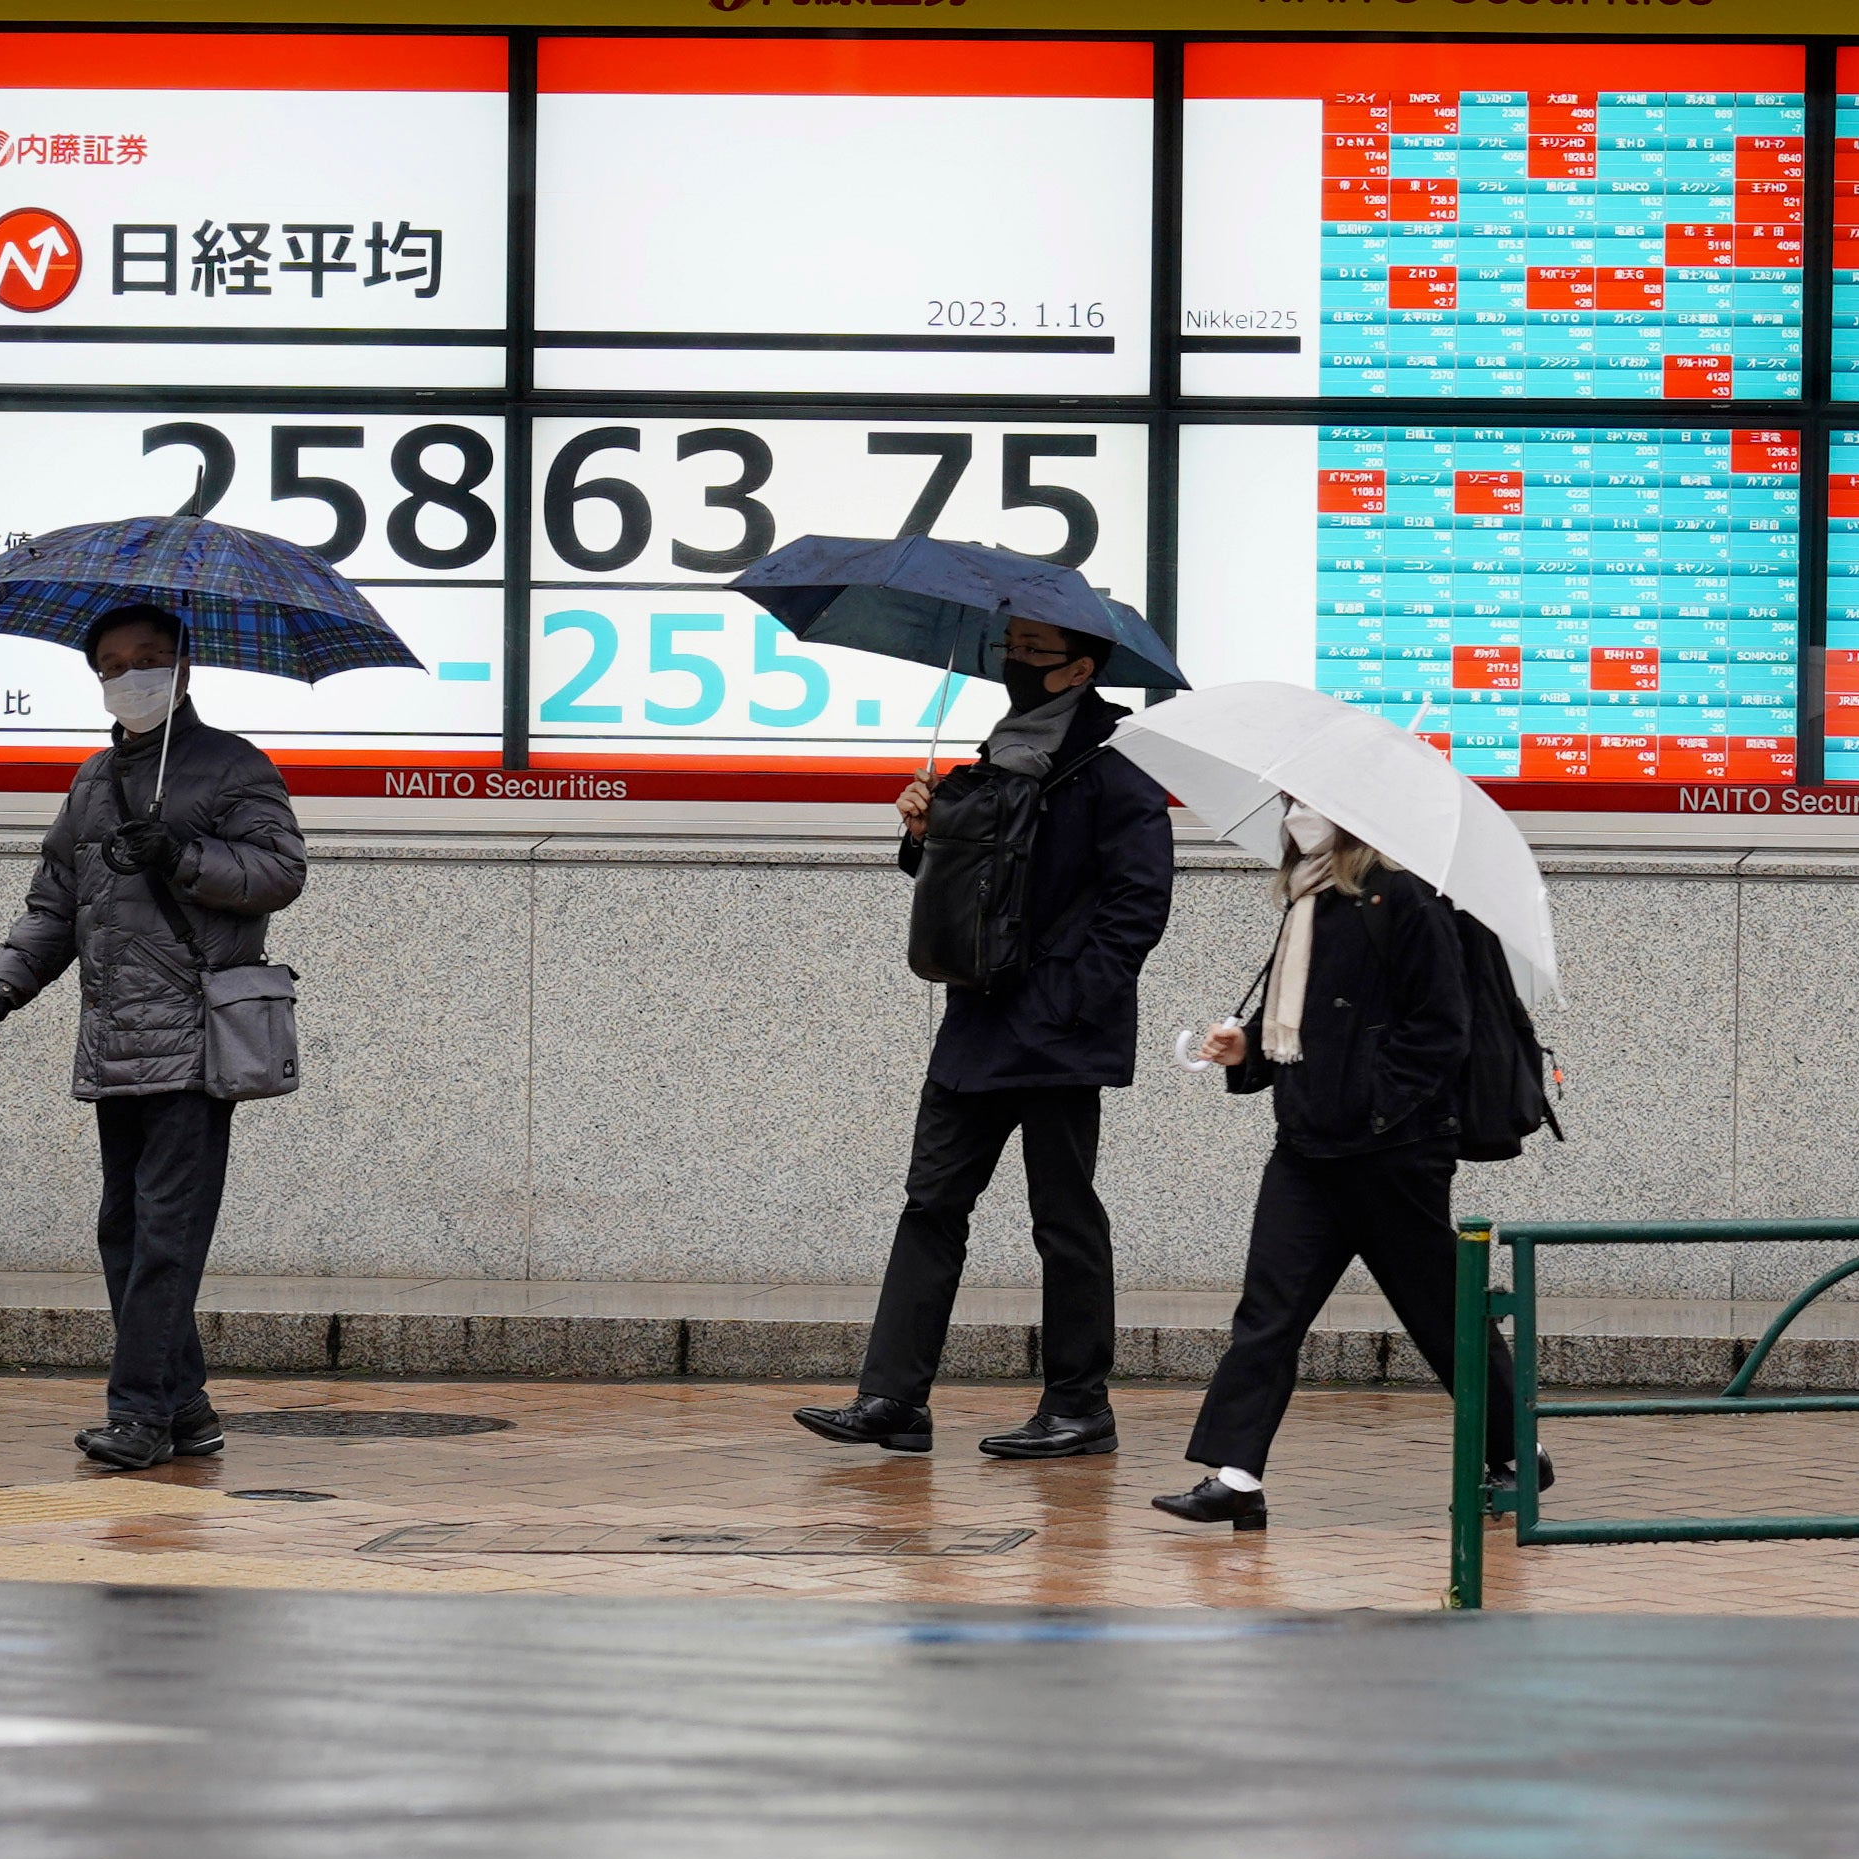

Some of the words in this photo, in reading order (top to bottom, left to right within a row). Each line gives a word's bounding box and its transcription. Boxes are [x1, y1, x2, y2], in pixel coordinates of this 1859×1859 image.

[1337, 94, 1376, 103] ニッスイ
[1409, 94, 1440, 103] INPEX
[1547, 95, 1578, 104] 大成建
[1370, 108, 1388, 118] 522
[1571, 109, 1595, 118] 4090
[1336, 138, 1375, 146] DeNA
[1478, 138, 1508, 148] アサヒ
[1539, 138, 1586, 148] キリンHD
[16, 133, 149, 166] 内藤証券
[1365, 152, 1387, 160] 1744
[1477, 182, 1508, 192] クラレ
[1611, 182, 1650, 192] SUMCO
[1679, 182, 1720, 192] ネクソン
[1751, 182, 1787, 193] 王子HD
[1364, 195, 1387, 205] 1269
[1429, 196, 1456, 205] 738.9
[1783, 197, 1800, 207] 521
[1403, 225, 1444, 235] 三井化学
[1546, 226, 1575, 236] UBE
[111, 218, 444, 299] 日経平均
[1339, 269, 1369, 278] DIC
[1409, 269, 1437, 278] ZHD
[1614, 269, 1644, 280] 楽天G
[1429, 283, 1455, 292] 346.7
[926, 300, 1017, 328] 2023.
[1034, 301, 1105, 329] 1.16
[1186, 309, 1298, 330] Nikkei225
[1541, 313, 1580, 323] TOTO
[1614, 313, 1645, 324] ガイシ
[1333, 356, 1372, 366] DOWA
[1539, 356, 1580, 367] フジクラ
[1609, 357, 1650, 367] しずおか
[1747, 357, 1787, 368] オークマ
[1706, 372, 1731, 382] 4120
[1331, 428, 1372, 439] ダイキン
[1474, 430, 1504, 440] NTN
[1750, 432, 1781, 442] 三菱電
[1767, 447, 1797, 456] 1296.5
[1469, 474, 1508, 484] ソニーG
[1543, 474, 1572, 484] TDK
[1403, 560, 1434, 570] ニコン
[1606, 562, 1645, 572] HOYA
[1747, 563, 1779, 574] リコー
[1604, 650, 1645, 660] 野村HD
[1487, 663, 1519, 673] 2171.5
[1466, 735, 1504, 746] KDDI
[1771, 754, 1794, 763] 1222
[384, 771, 476, 797] NAITO
[485, 773, 628, 799] Securities
[1679, 787, 1772, 812] NAITO
